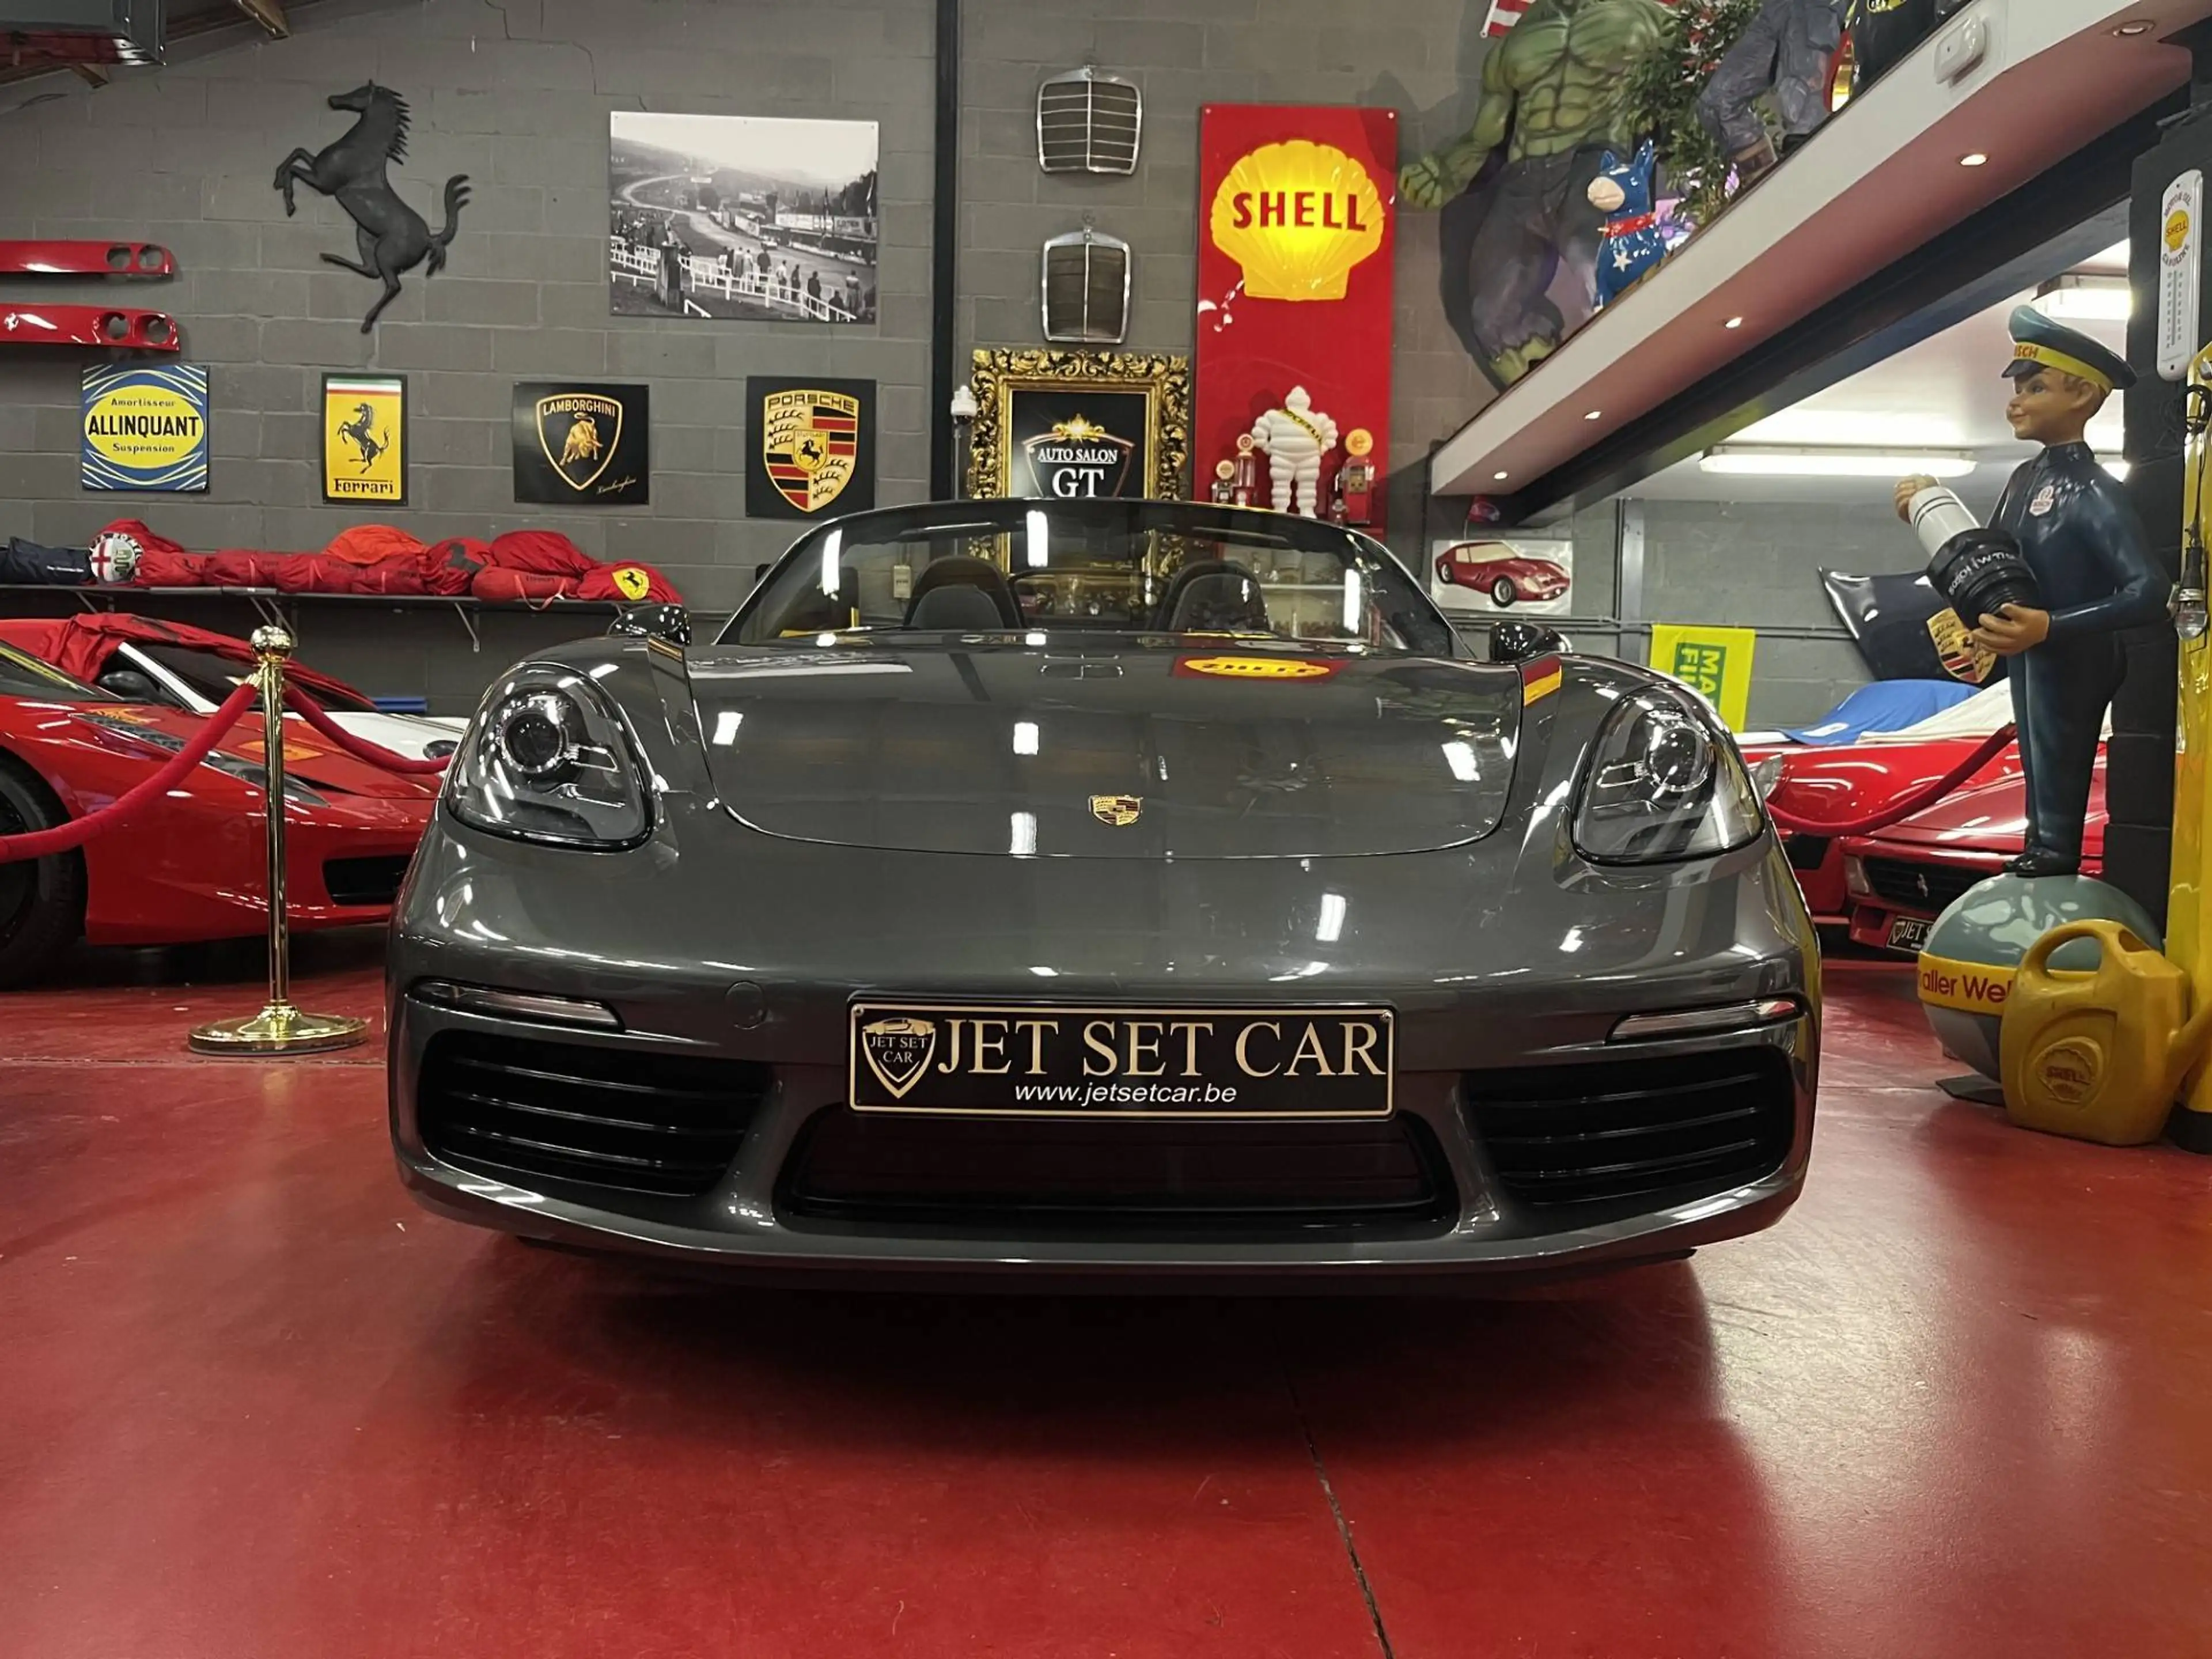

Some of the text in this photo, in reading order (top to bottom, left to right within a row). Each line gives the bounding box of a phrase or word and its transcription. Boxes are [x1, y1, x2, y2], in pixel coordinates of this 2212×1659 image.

[1233, 192, 1367, 232] SHELL
[2165, 220, 2188, 237] SHELL
[111, 397, 175, 407] Amortisseur
[543, 399, 615, 417] LAMBORGHINI
[768, 394, 855, 413] PORSCHE
[88, 415, 199, 438] ALLINQUANT
[112, 442, 175, 454] Suspension
[1037, 448, 1118, 463] AUTO SALON
[334, 478, 394, 494] Ferrari
[1052, 467, 1104, 497] GT
[1699, 650, 1721, 705] MA
[1902, 922, 1925, 940] JET
[1922, 969, 1957, 997] aller
[870, 1037, 928, 1048] JET SET
[938, 1019, 1387, 1077] JET SET CAR
[883, 1051, 914, 1064] CAR
[1015, 1083, 1237, 1107] www.jetsetcar.be
